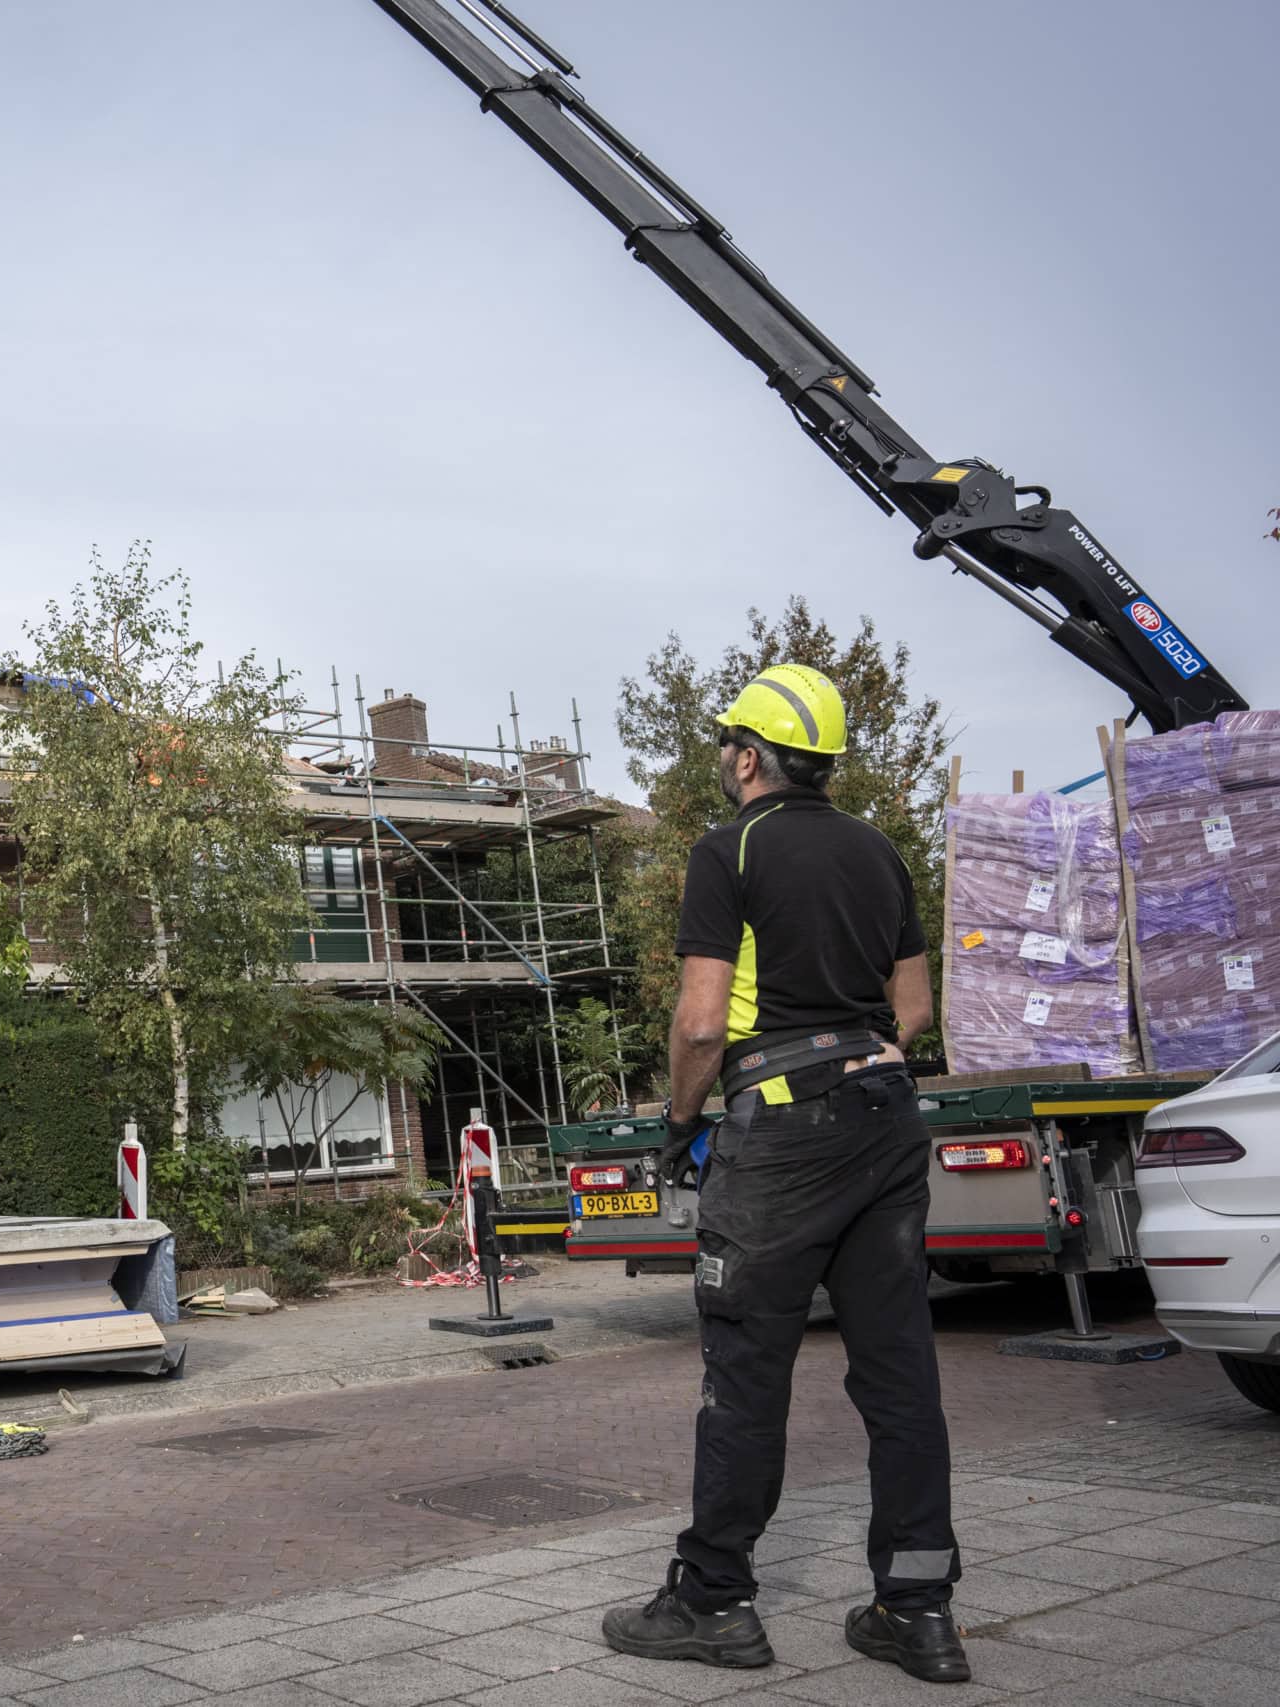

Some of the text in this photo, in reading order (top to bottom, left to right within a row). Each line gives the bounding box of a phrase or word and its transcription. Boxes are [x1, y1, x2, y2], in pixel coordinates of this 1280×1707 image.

[1068, 524, 1139, 596] POWER TO LIFT
[1133, 604, 1160, 628] HMF
[1157, 630, 1201, 674] 5020
[586, 1194, 652, 1213] 90-BXL-3
